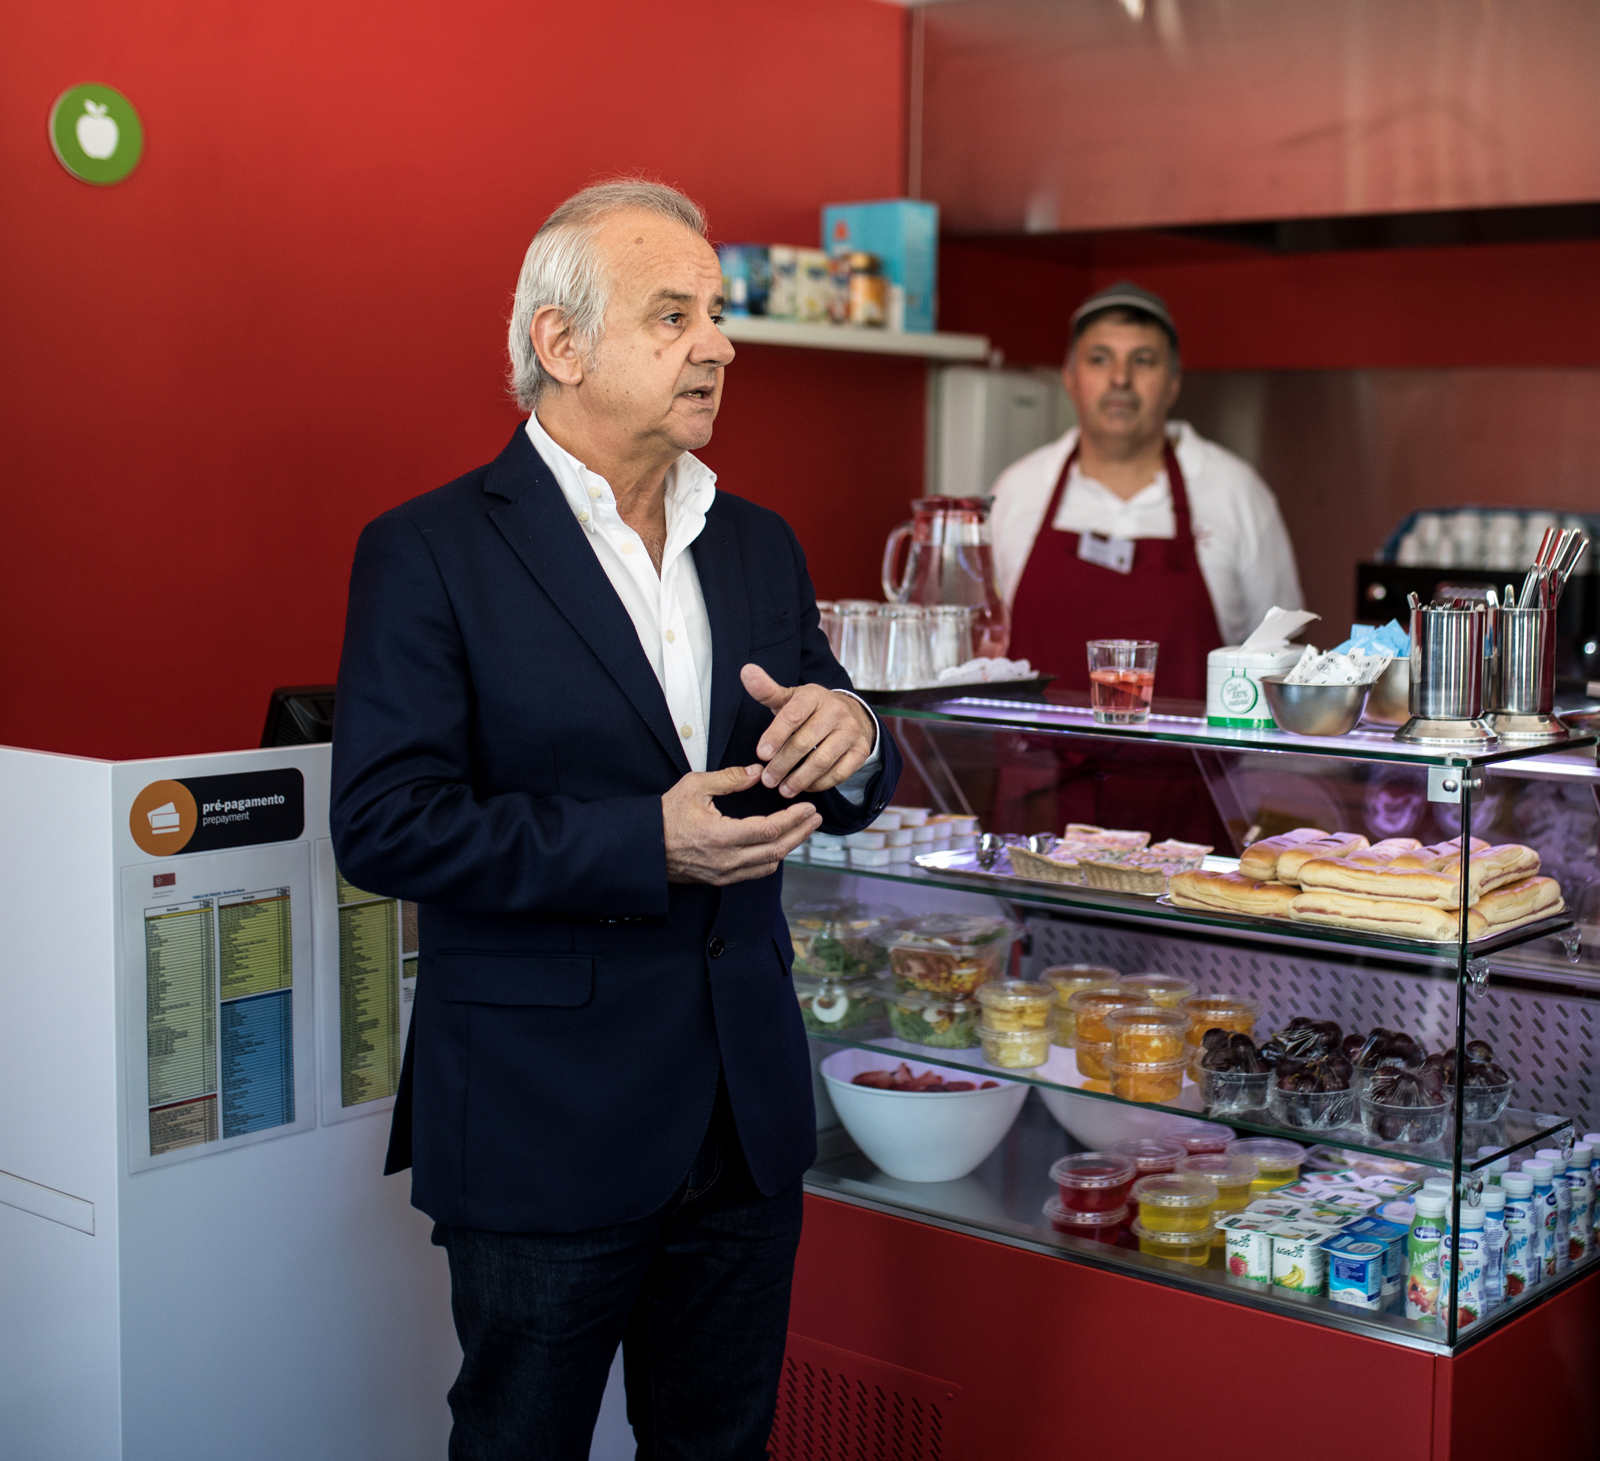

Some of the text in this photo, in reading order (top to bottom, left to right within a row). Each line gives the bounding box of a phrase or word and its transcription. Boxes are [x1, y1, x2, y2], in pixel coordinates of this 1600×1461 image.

[1232, 689, 1248, 699] 100%
[202, 793, 286, 815] pré-pagamento
[202, 811, 250, 827] prepayment
[1415, 1228, 1441, 1239] Mimosa
[1445, 1237, 1478, 1248] Mmosa
[1508, 1236, 1528, 1260] gro
[1413, 1247, 1438, 1268] Arom
